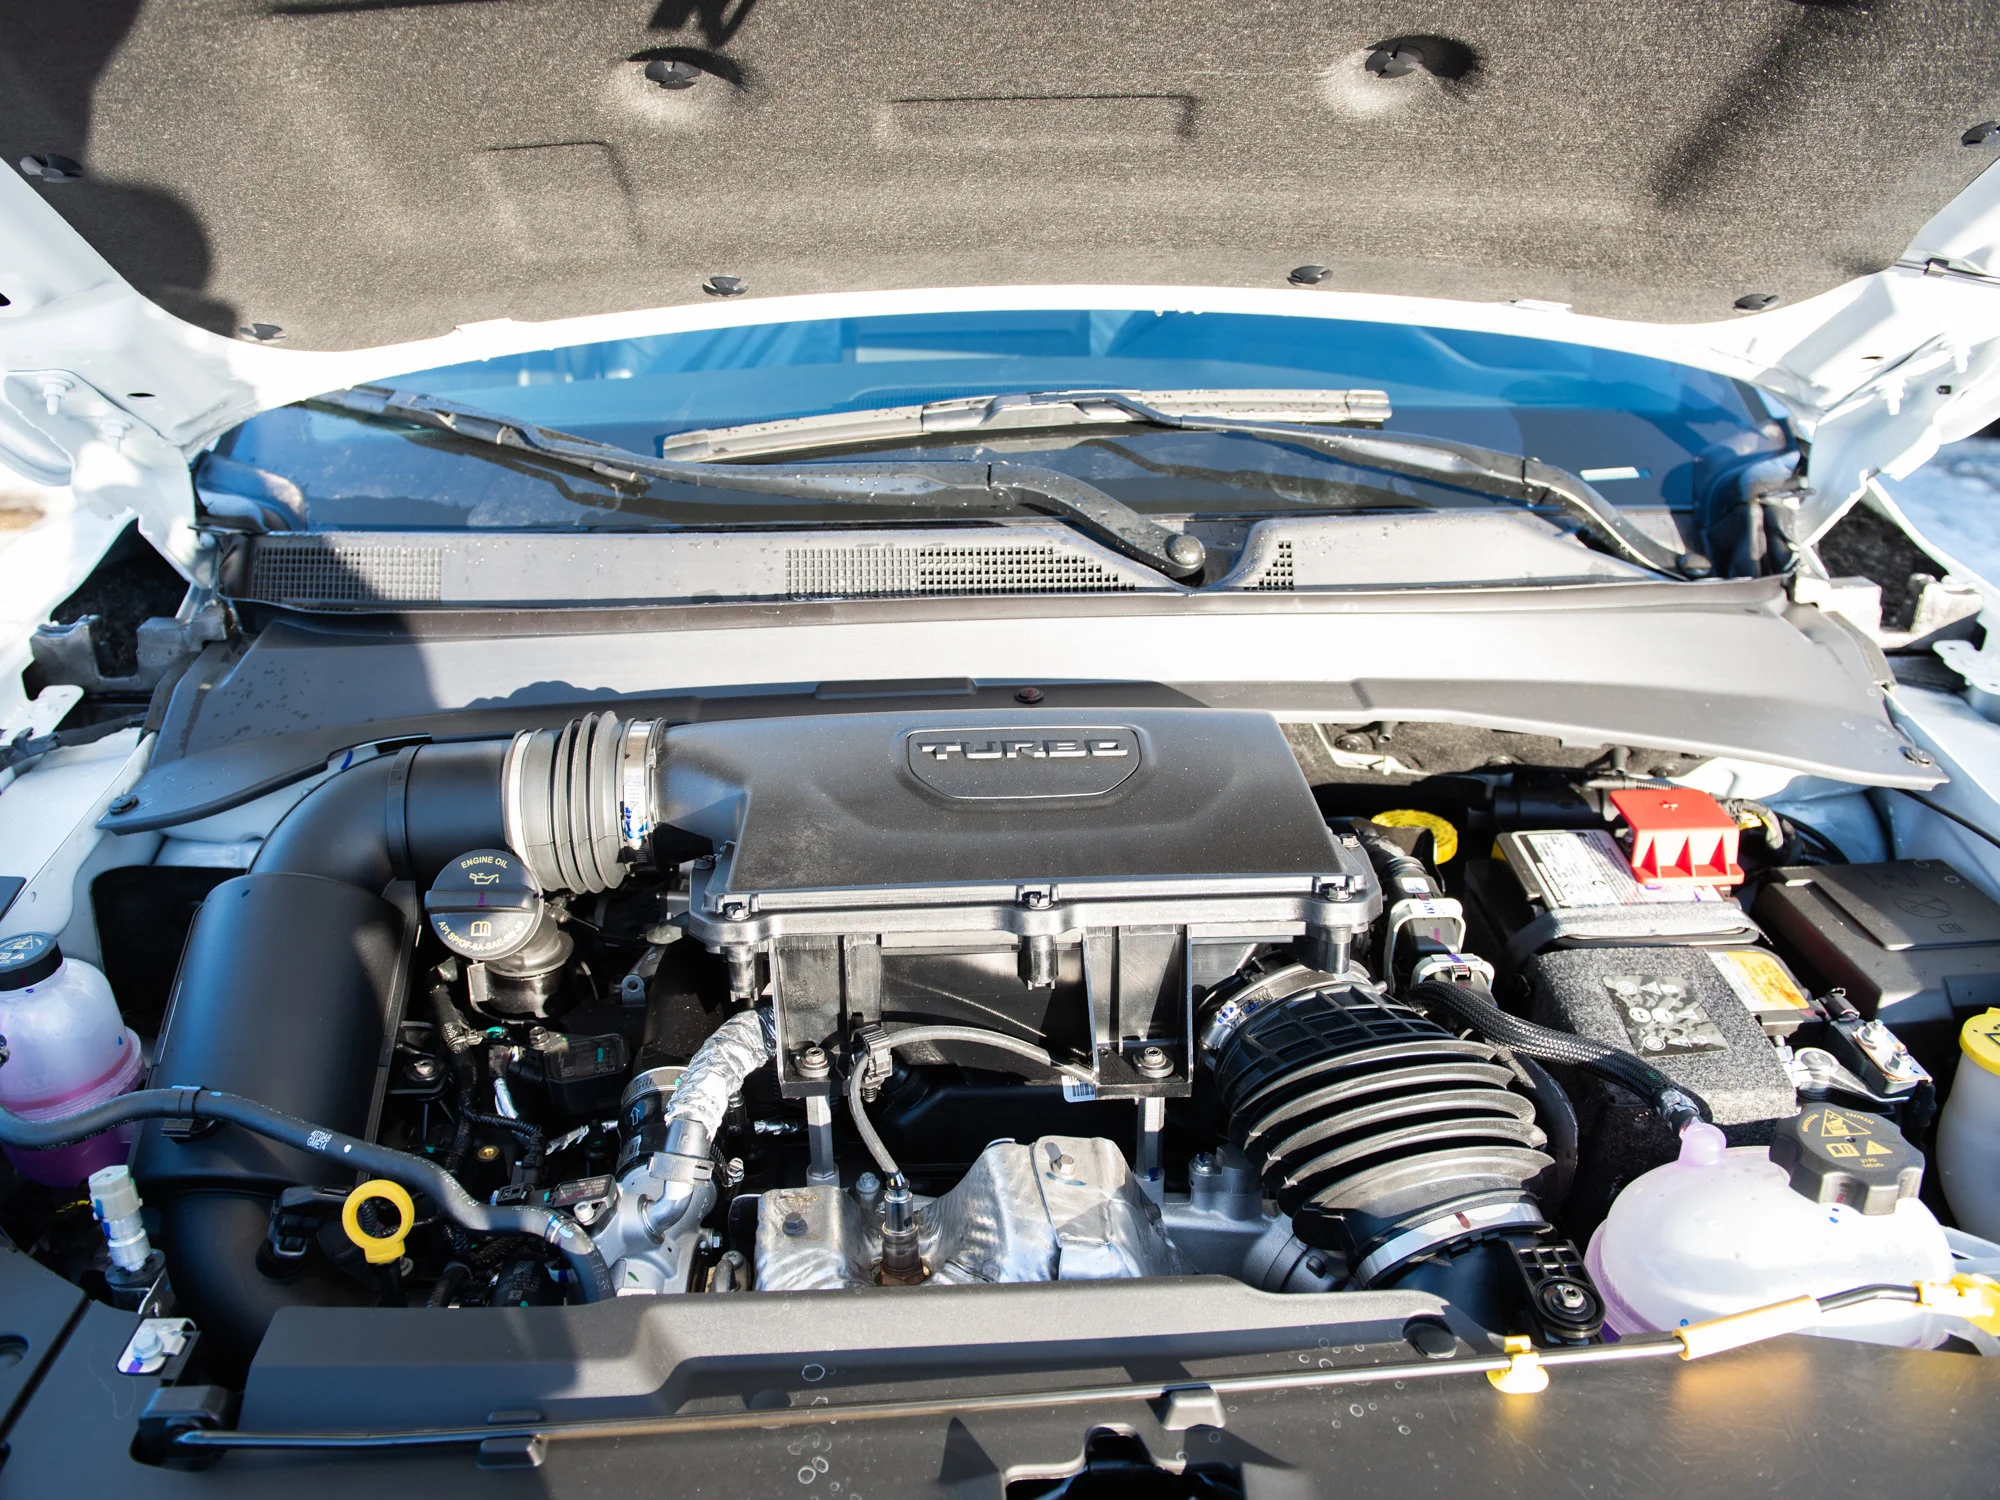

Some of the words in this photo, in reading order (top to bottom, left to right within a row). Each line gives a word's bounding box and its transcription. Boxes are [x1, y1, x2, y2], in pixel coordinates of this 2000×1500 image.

[917, 739, 1128, 760] TURBO
[461, 856, 493, 869] ENGINE
[495, 858, 508, 869] OIL
[438, 921, 449, 935] API
